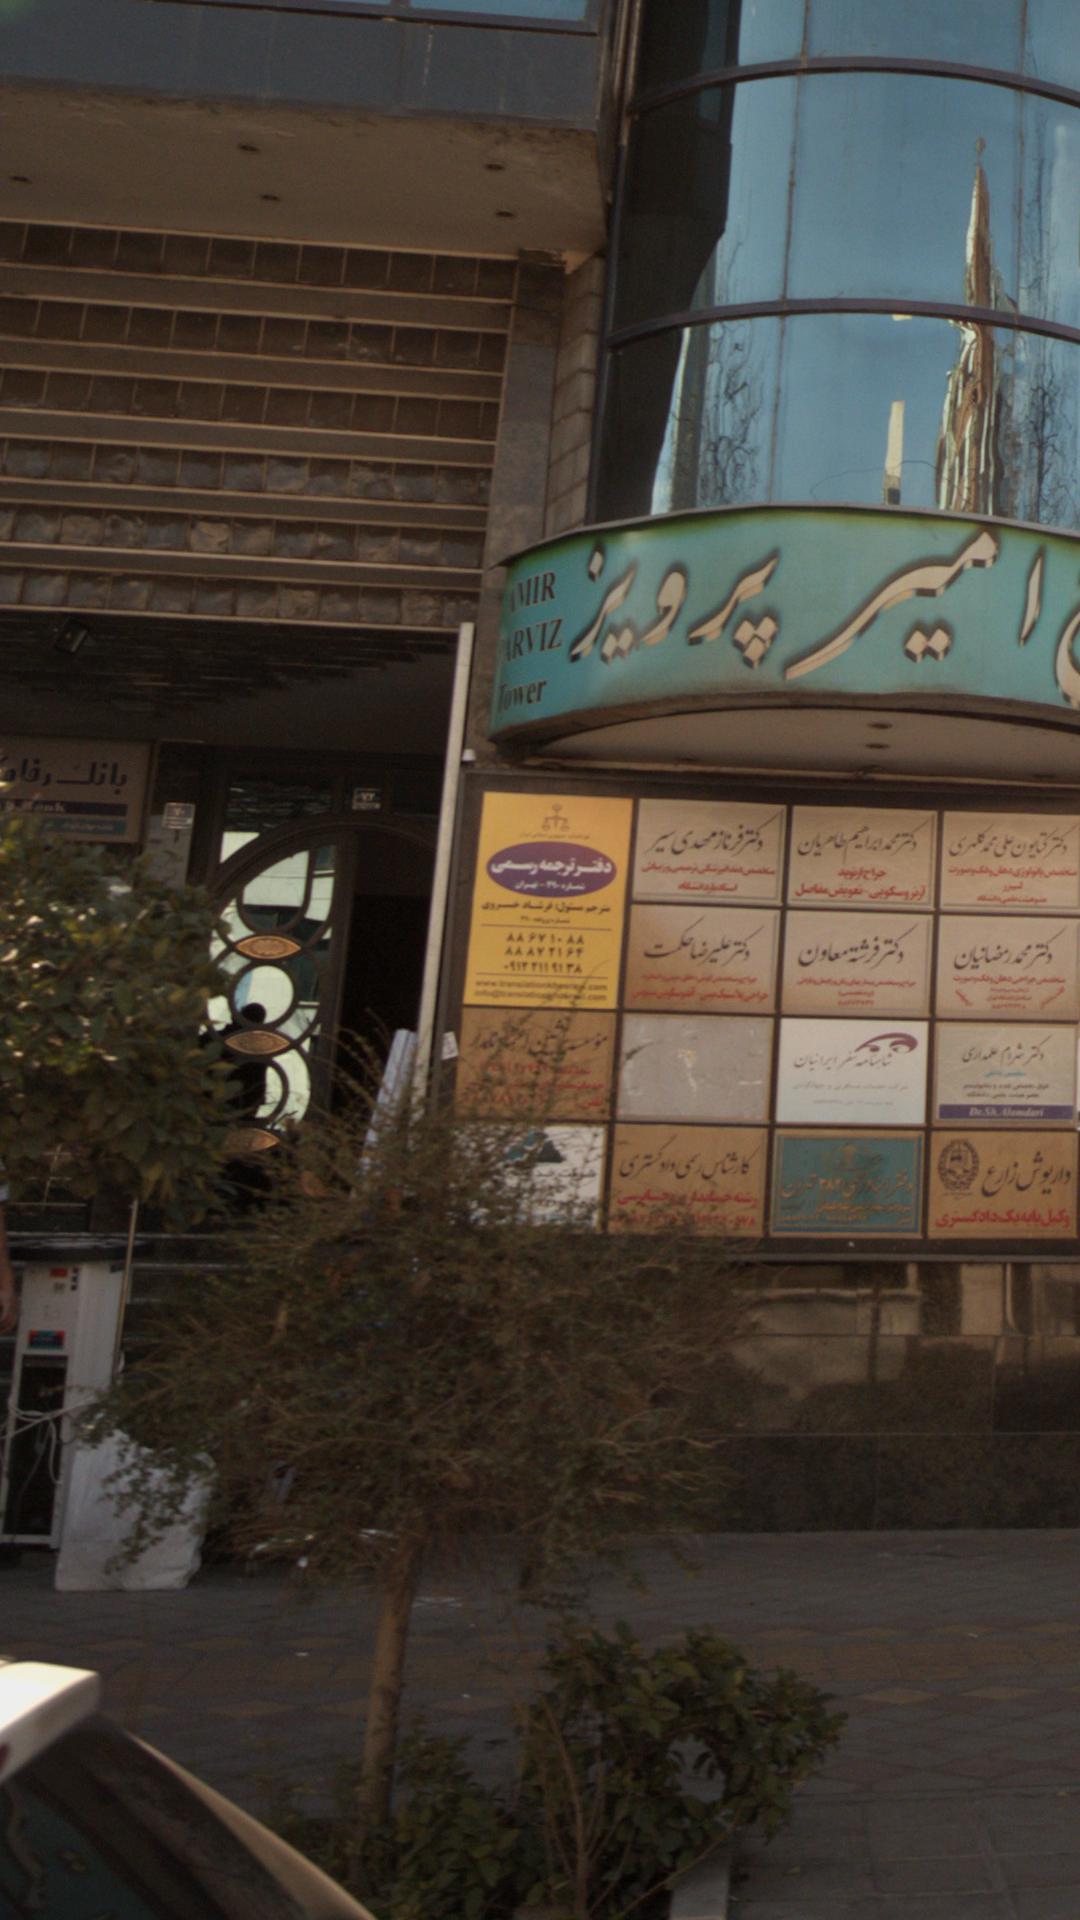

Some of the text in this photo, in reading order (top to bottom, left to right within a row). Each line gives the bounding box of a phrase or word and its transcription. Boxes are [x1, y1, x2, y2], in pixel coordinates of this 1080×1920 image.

[568, 541, 780, 670] پرویز
[784, 529, 1044, 682] امیر
[730, 808, 785, 858] دکتر
[889, 818, 929, 857] دکتر
[490, 857, 613, 877] دفتر ترجمه رسمی
[721, 924, 765, 967] دکتر
[797, 922, 919, 970] دکتر فرشته معاون
[1022, 924, 1067, 970] دکتر
[1022, 1033, 1054, 1066] دکتر
[1015, 1150, 1073, 1195] داریوش
